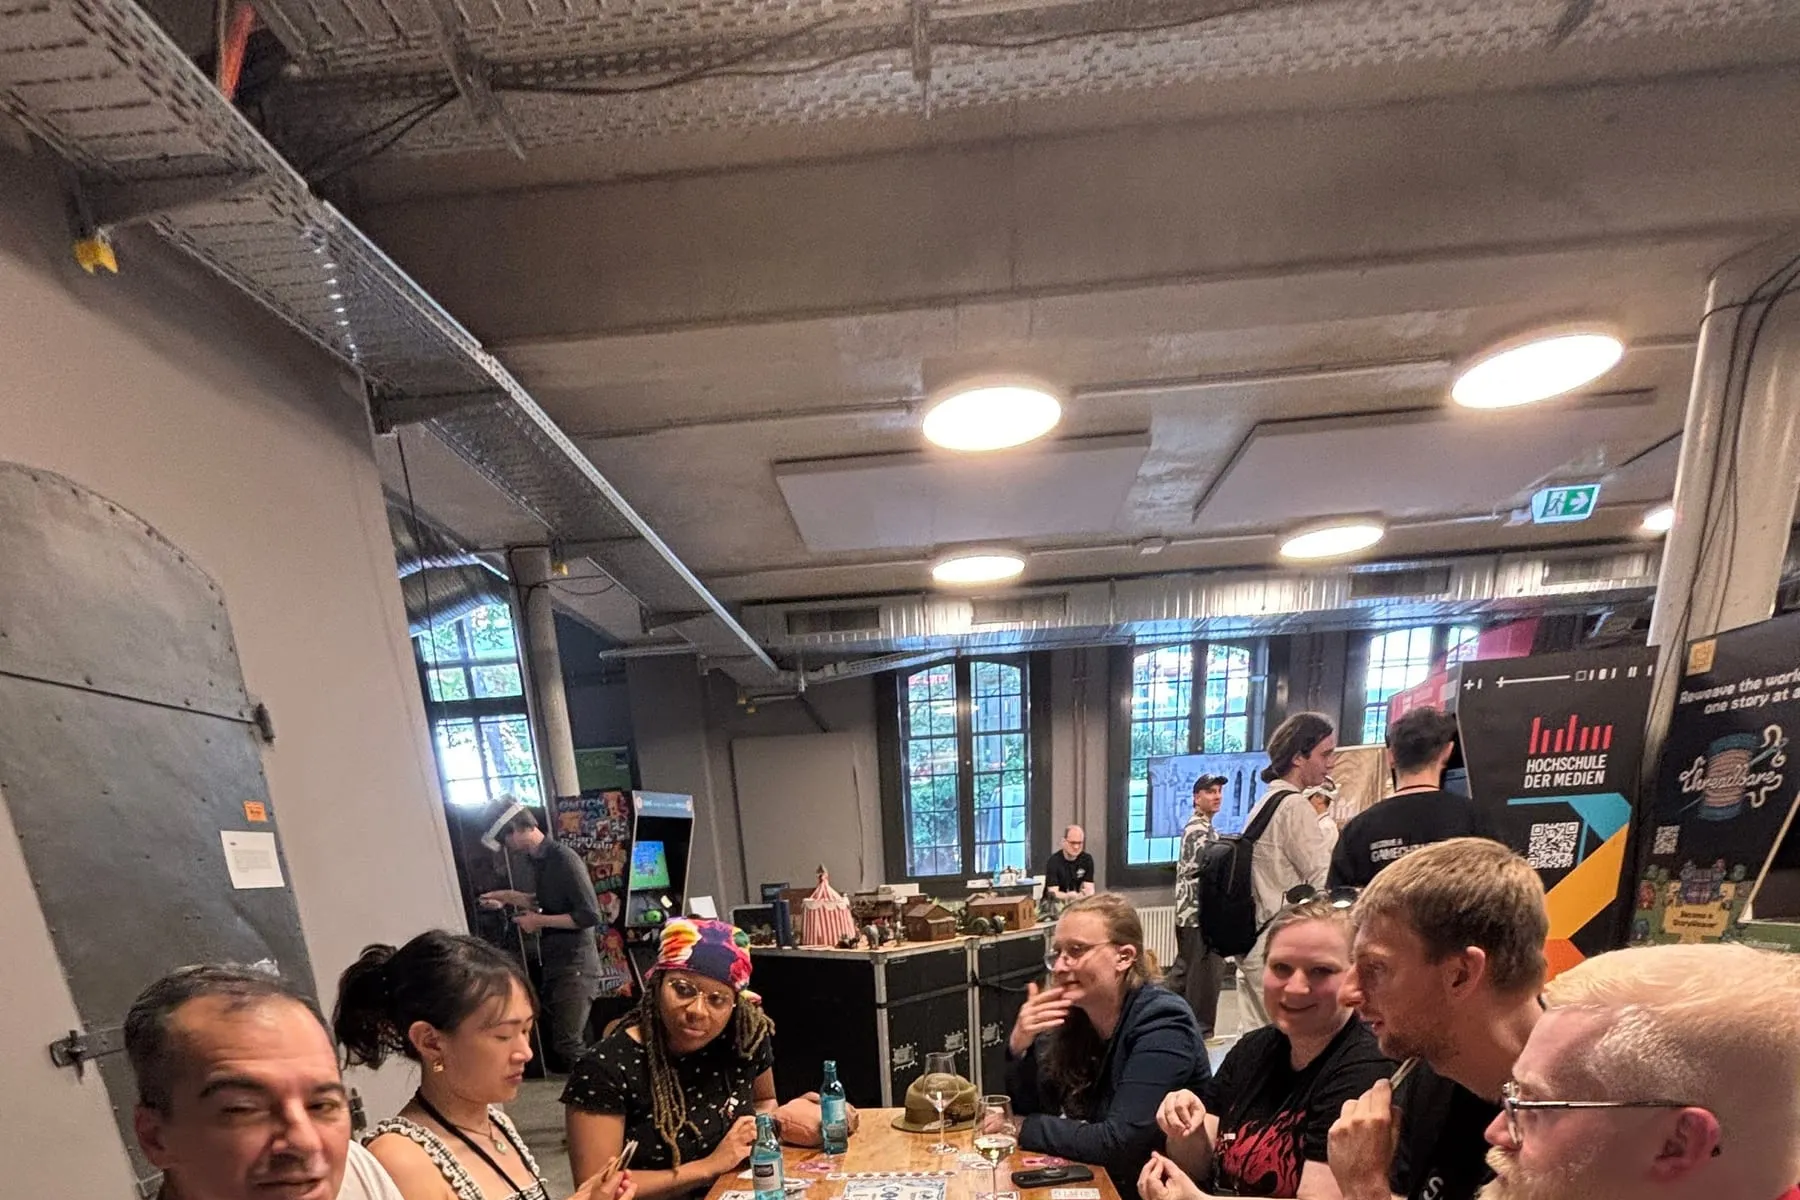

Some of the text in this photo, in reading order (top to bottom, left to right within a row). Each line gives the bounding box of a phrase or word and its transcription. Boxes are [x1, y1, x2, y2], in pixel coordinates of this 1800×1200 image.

[1739, 677, 1763, 693] the
[1765, 667, 1800, 688] worl
[1704, 701, 1728, 715] one
[1731, 693, 1770, 711] story
[1772, 687, 1789, 703] at
[1526, 754, 1608, 773] HOCHSCHULE
[1524, 770, 1605, 789] DER MEDIEN
